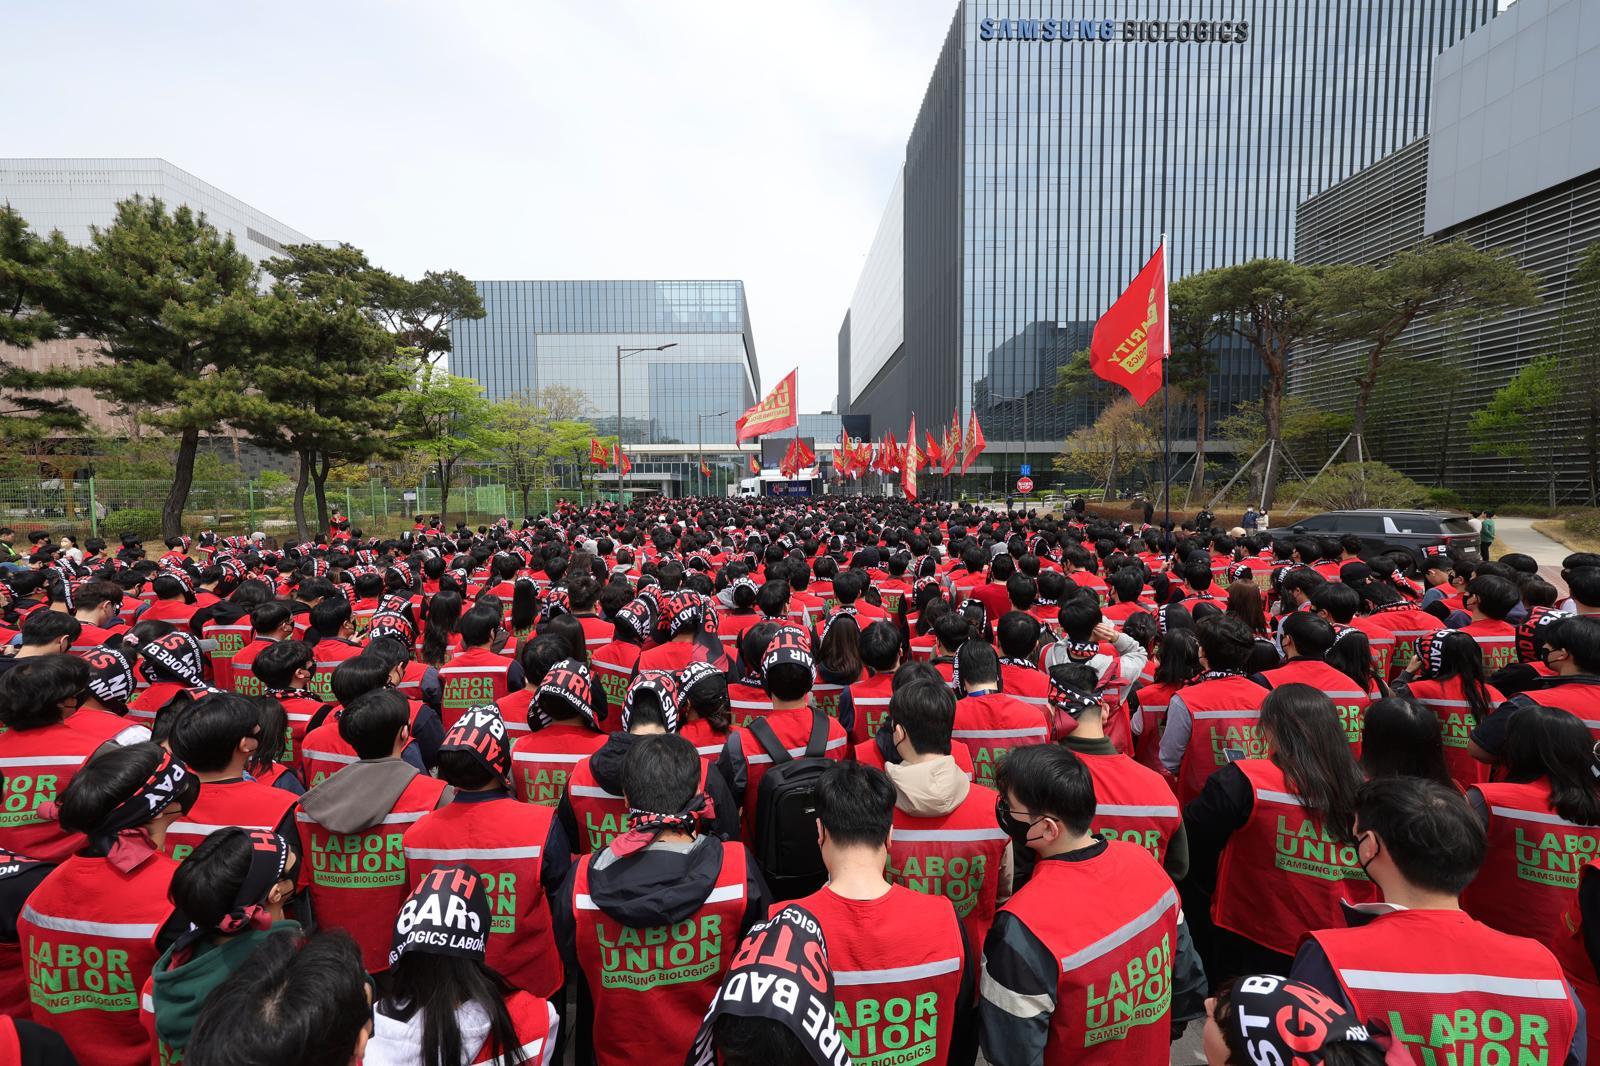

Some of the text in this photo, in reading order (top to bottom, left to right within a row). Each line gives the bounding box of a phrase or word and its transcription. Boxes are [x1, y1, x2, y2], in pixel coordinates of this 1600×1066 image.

[980, 17, 1250, 43] SAMSUNG BIOLOGICS
[600, 673, 629, 689] ABO
[443, 687, 494, 699] UNION
[561, 689, 583, 708] LABOR
[1210, 725, 1265, 741] LABO
[523, 768, 568, 785] LAB
[526, 784, 564, 800] UNI
[311, 833, 403, 853] LABOR
[1276, 834, 1360, 867] UNIO
[1515, 827, 1600, 853] LABO
[311, 851, 406, 873] UNION
[1279, 856, 1331, 875] SAMSUNG
[316, 873, 401, 884] SAMSUNG BIOLOGICS
[1521, 868, 1577, 885] SAMSUNG
[596, 914, 722, 949] LABOR
[29, 935, 129, 971] LABOR
[600, 935, 722, 972] UNION
[30, 959, 137, 994] UNION
[604, 961, 716, 986] SAMSUNG BIOLOGICS
[74, 994, 132, 1006] BIOLOGICS
[723, 971, 800, 1015] BAD
[833, 991, 938, 1028] ABOR
[838, 1015, 938, 1056] NION
[1089, 1024, 1127, 1042] SAMSU
[1387, 1008, 1549, 1049] LABOR
